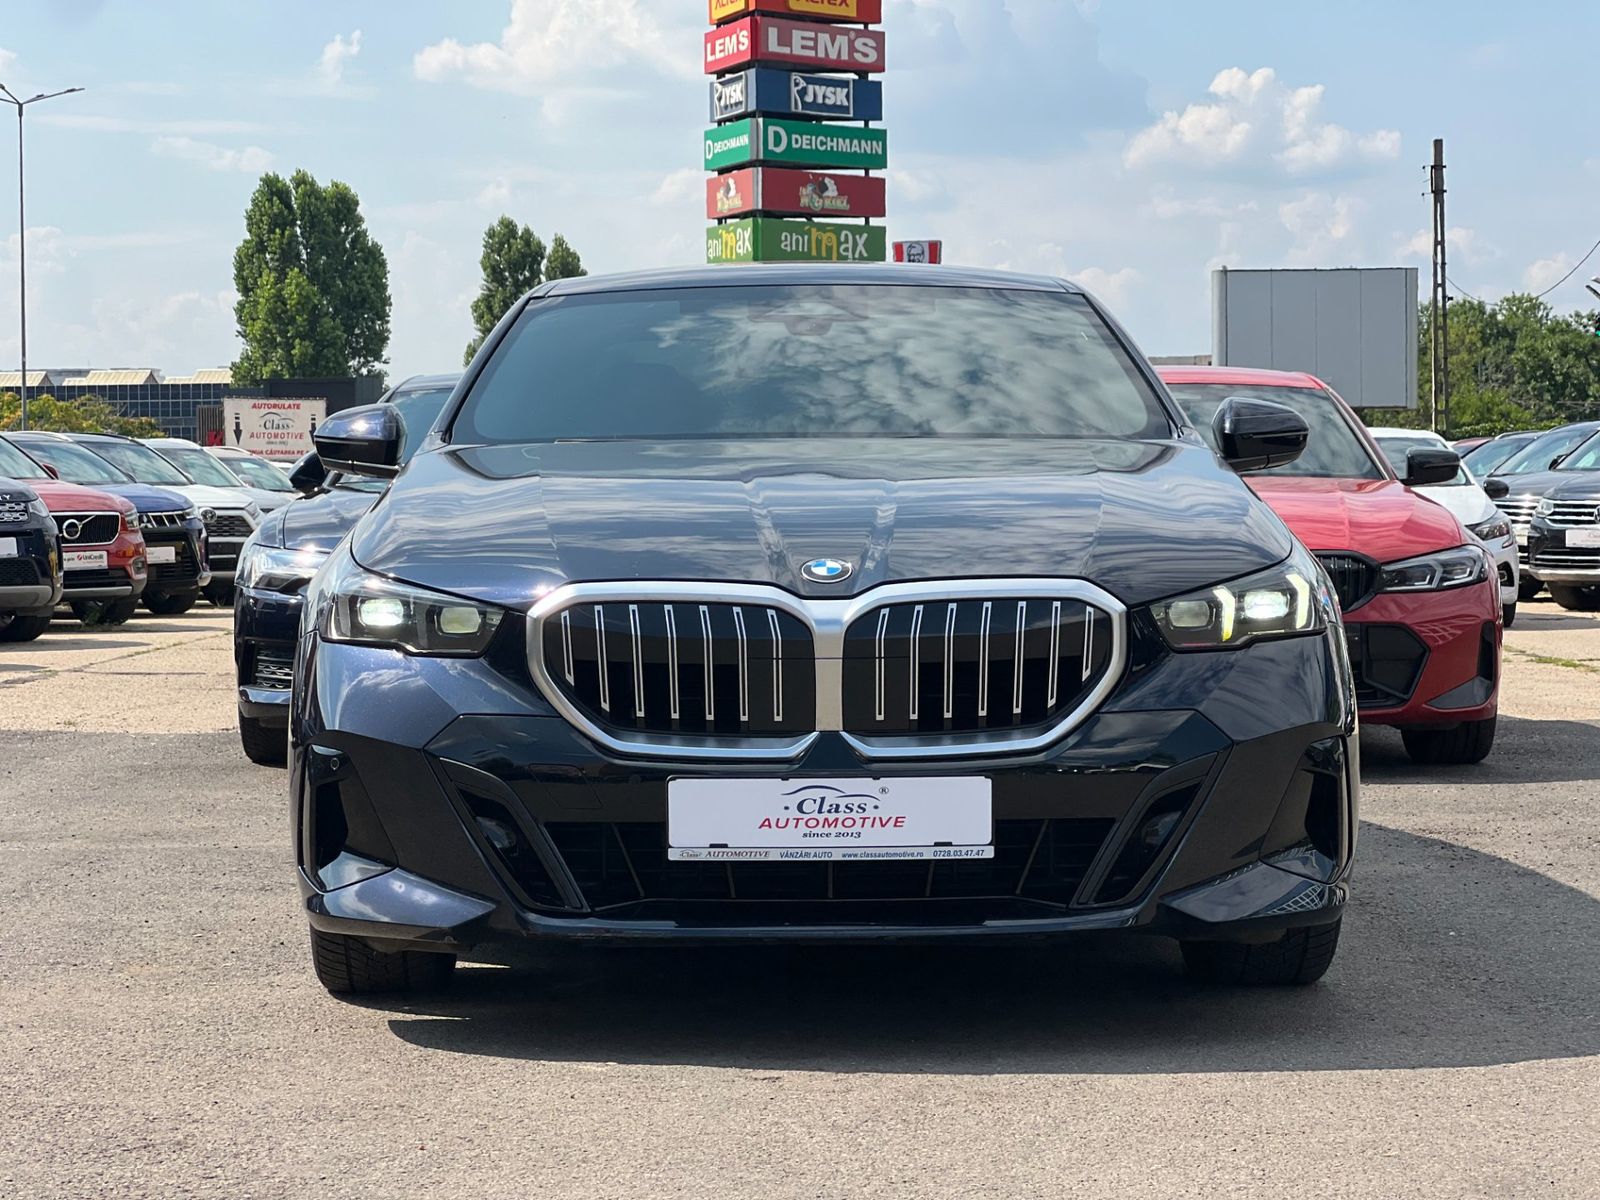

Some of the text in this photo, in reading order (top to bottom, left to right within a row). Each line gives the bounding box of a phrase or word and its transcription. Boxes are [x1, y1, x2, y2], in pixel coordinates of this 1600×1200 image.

[706, 28, 749, 63] LEM'S
[720, 83, 743, 106] JYSK
[805, 84, 849, 106] JYSK
[713, 134, 749, 153] DEICHMANN
[791, 134, 883, 155] DEICHMANN
[781, 227, 869, 262] animax
[263, 419, 290, 430] Class
[249, 432, 305, 440] AUTOMOTIVE
[796, 796, 868, 815] Class
[758, 816, 907, 829] AUTOMOTIVE
[802, 830, 862, 839] since 2013
[812, 850, 833, 859] AUTO
[841, 851, 924, 859] www.classautomotive.ro
[933, 849, 985, 858] 0728.03.47.47
